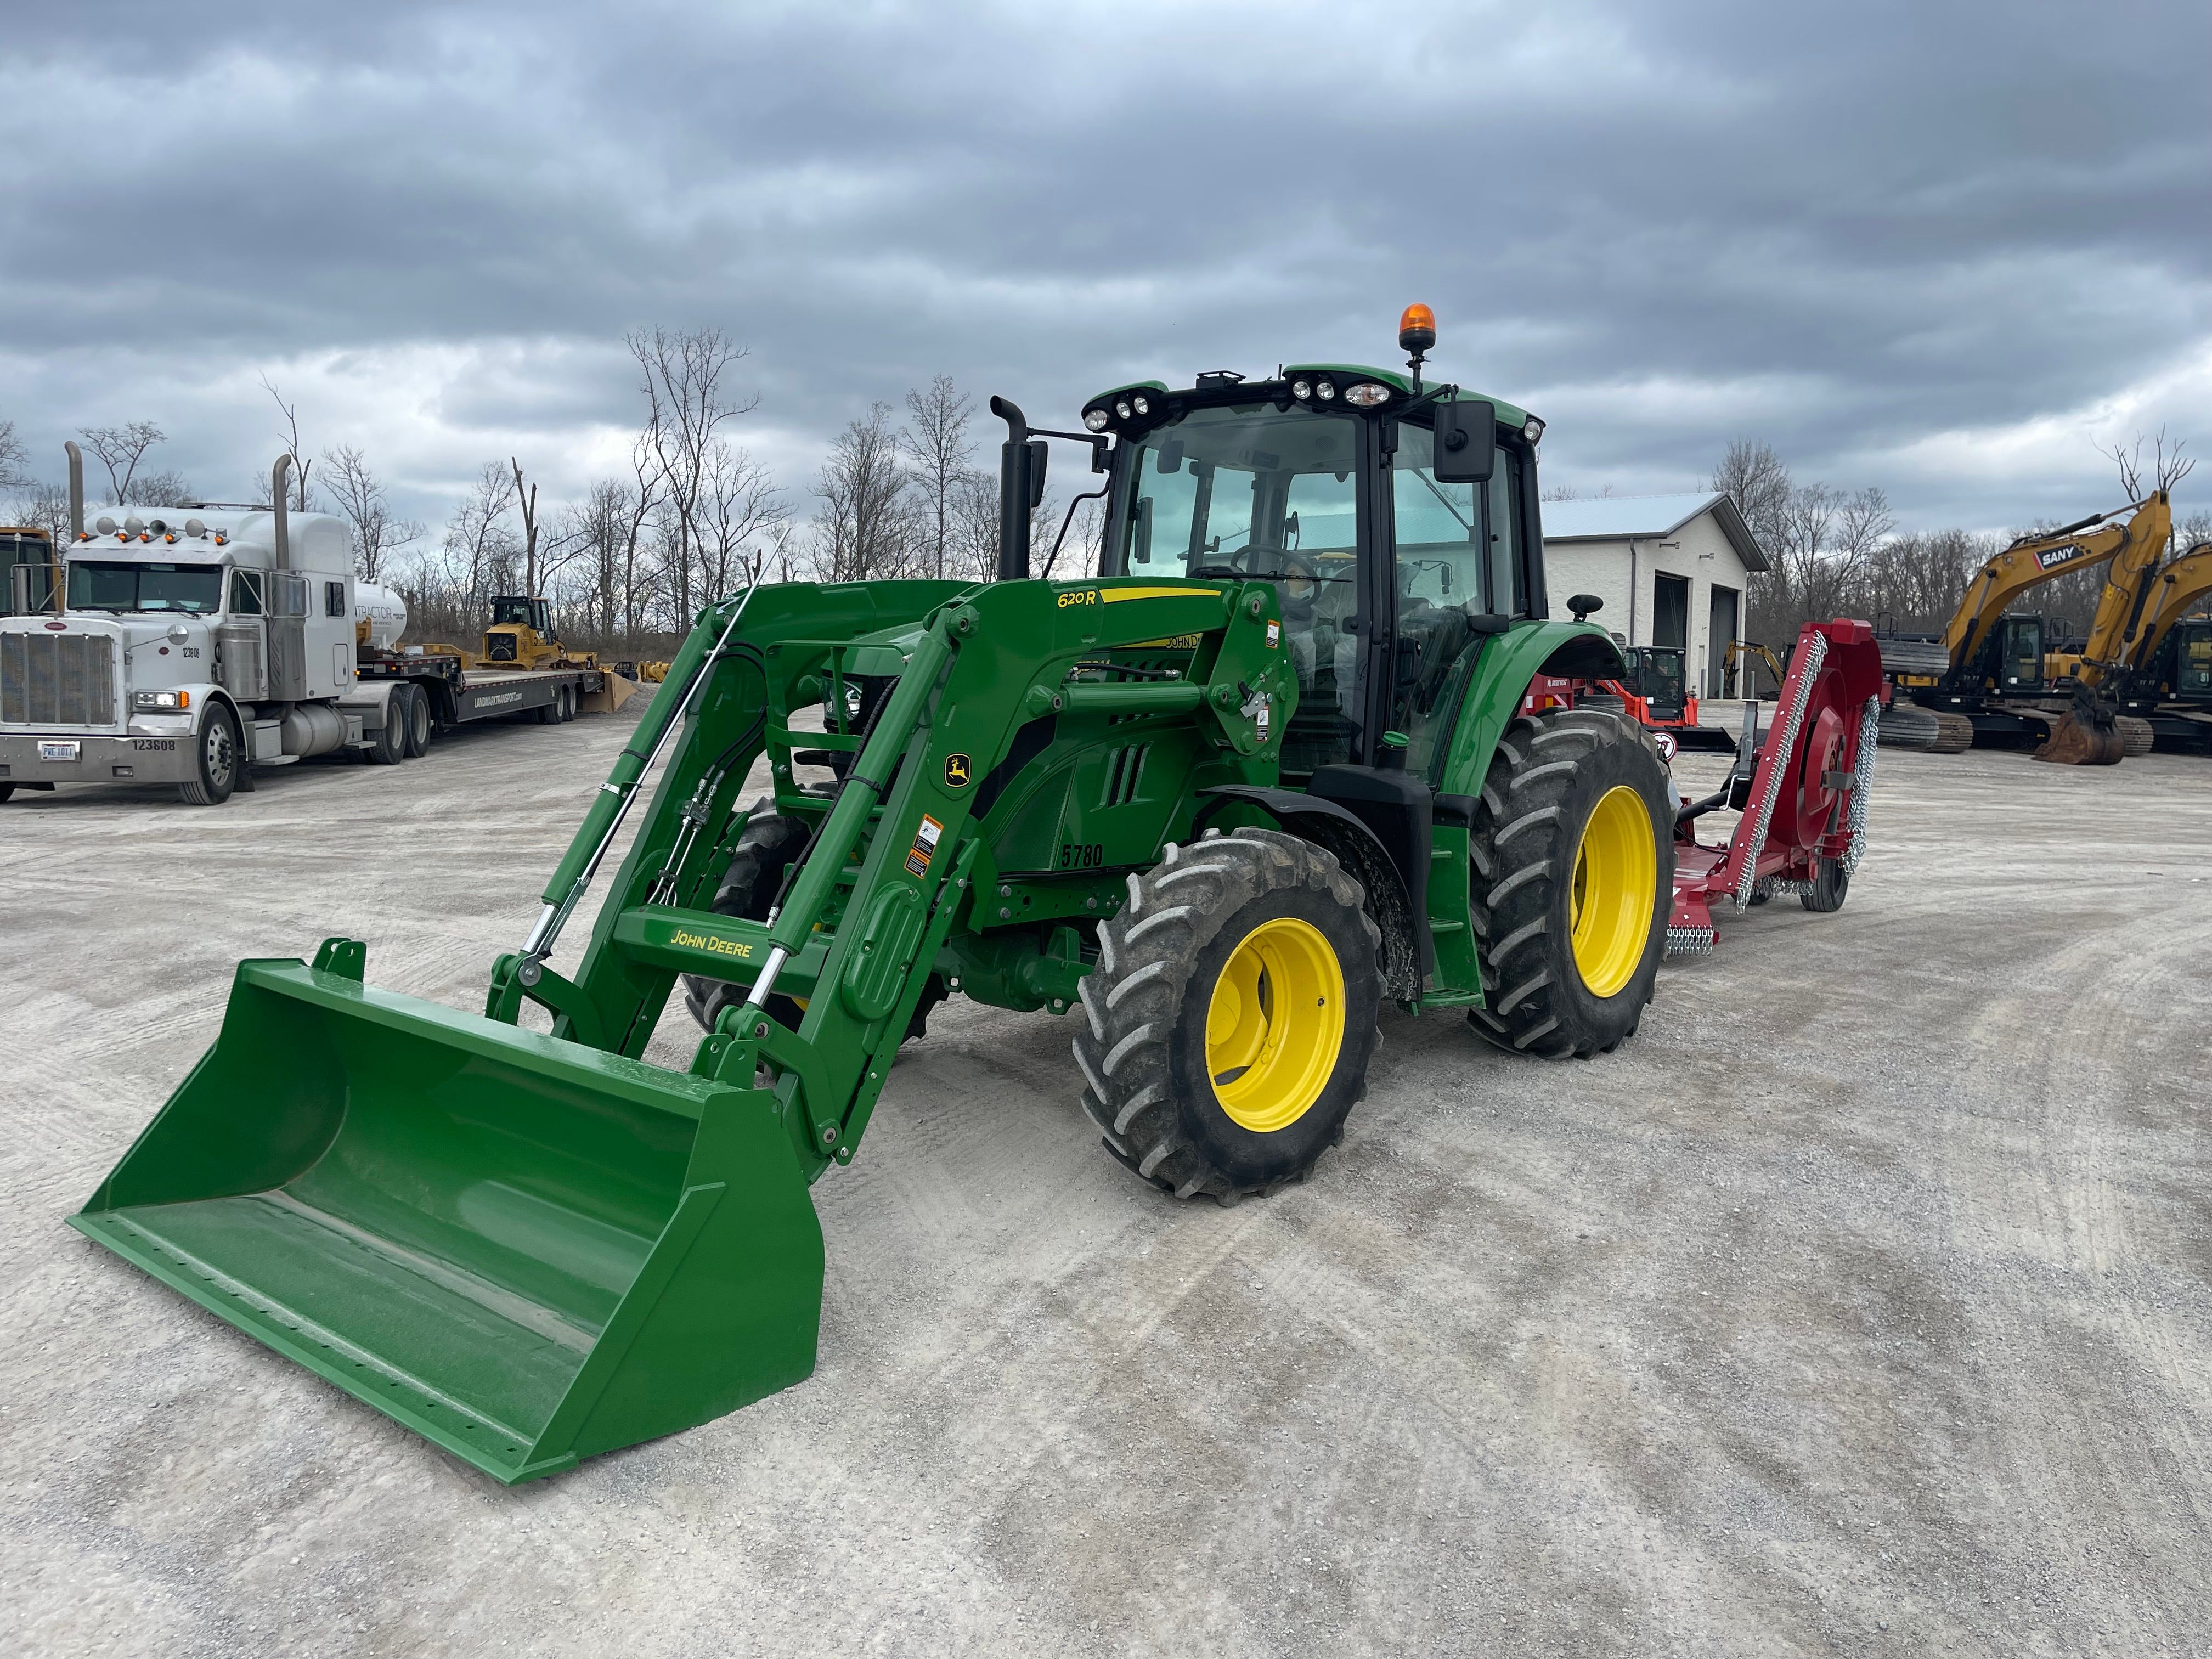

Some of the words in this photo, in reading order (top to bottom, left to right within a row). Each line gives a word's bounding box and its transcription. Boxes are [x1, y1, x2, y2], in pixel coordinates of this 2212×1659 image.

[2042, 546, 2074, 566] SANY
[1166, 637, 1190, 647] JOHN
[1061, 844, 1103, 867] 5780
[670, 930, 707, 949] JOHN
[707, 936, 753, 958] DEERE
